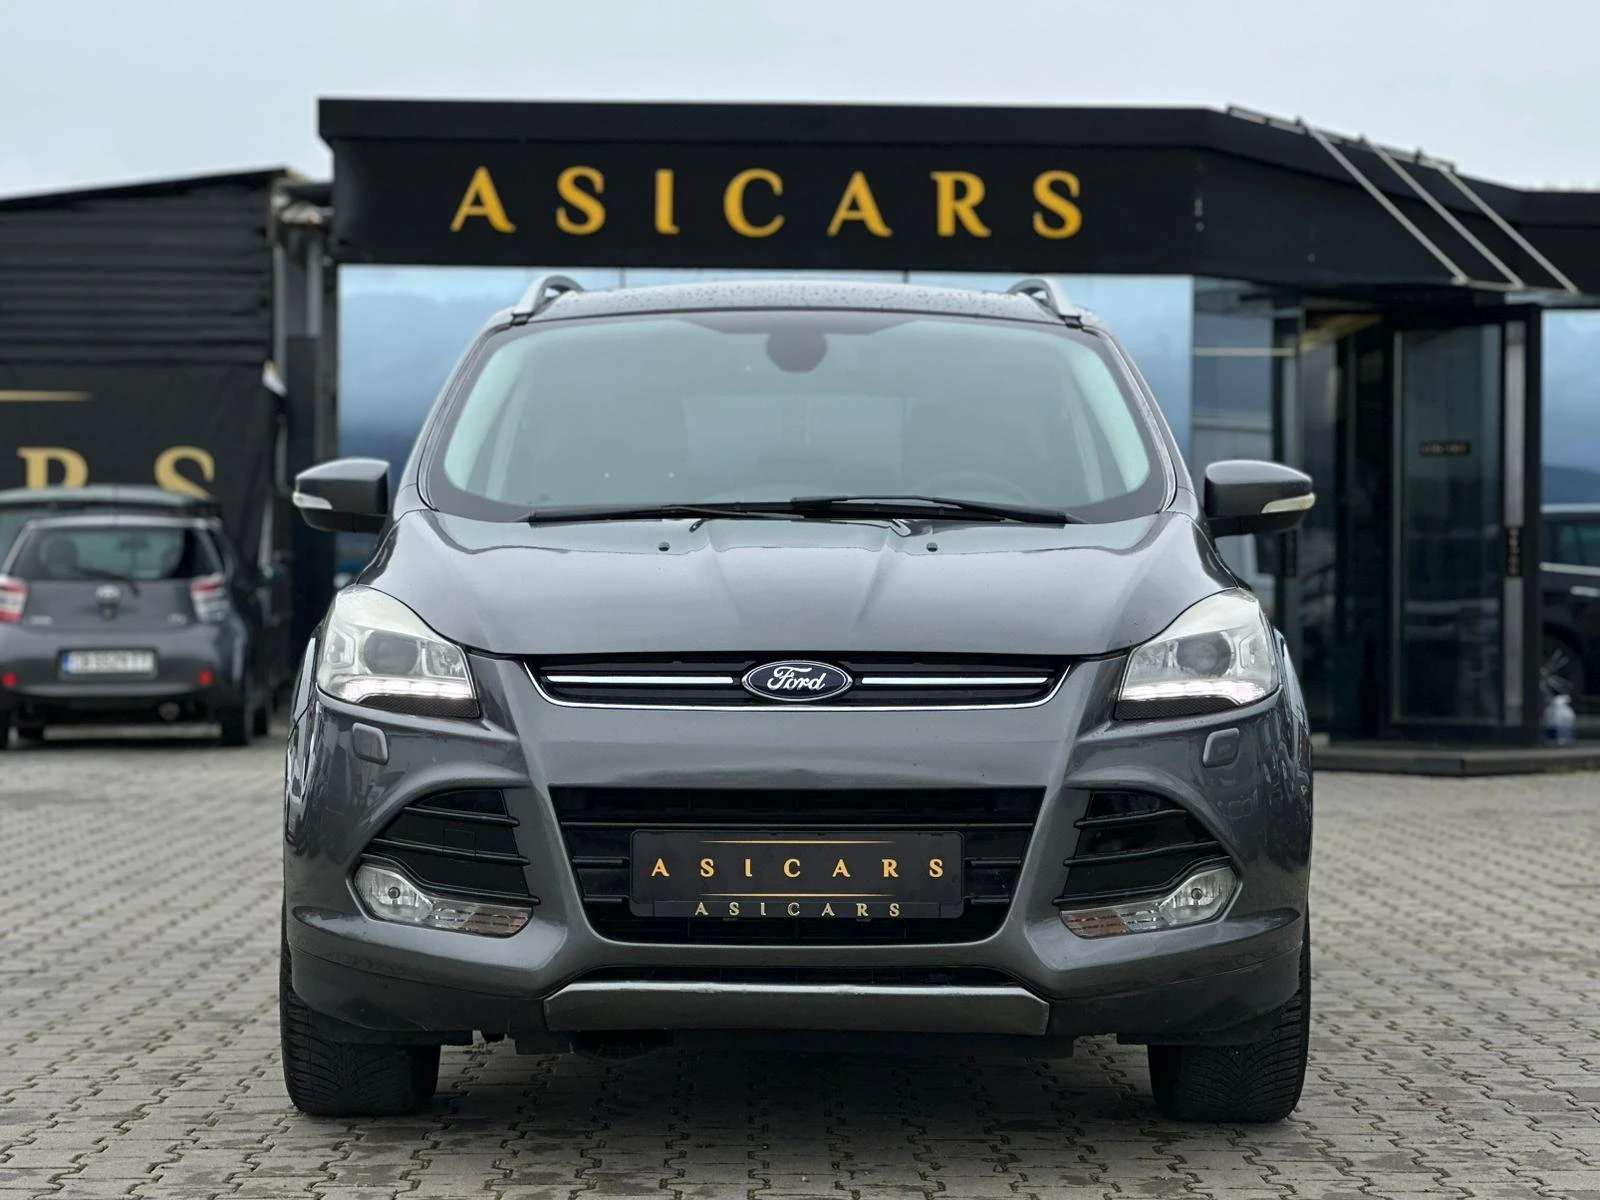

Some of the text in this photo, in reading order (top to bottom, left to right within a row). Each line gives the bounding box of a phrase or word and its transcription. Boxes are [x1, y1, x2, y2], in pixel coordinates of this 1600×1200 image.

[450, 165, 1083, 239] ASICARS
[766, 666, 827, 691] Ford
[650, 858, 944, 878] ASICARS
[694, 902, 901, 917] ASICARS
